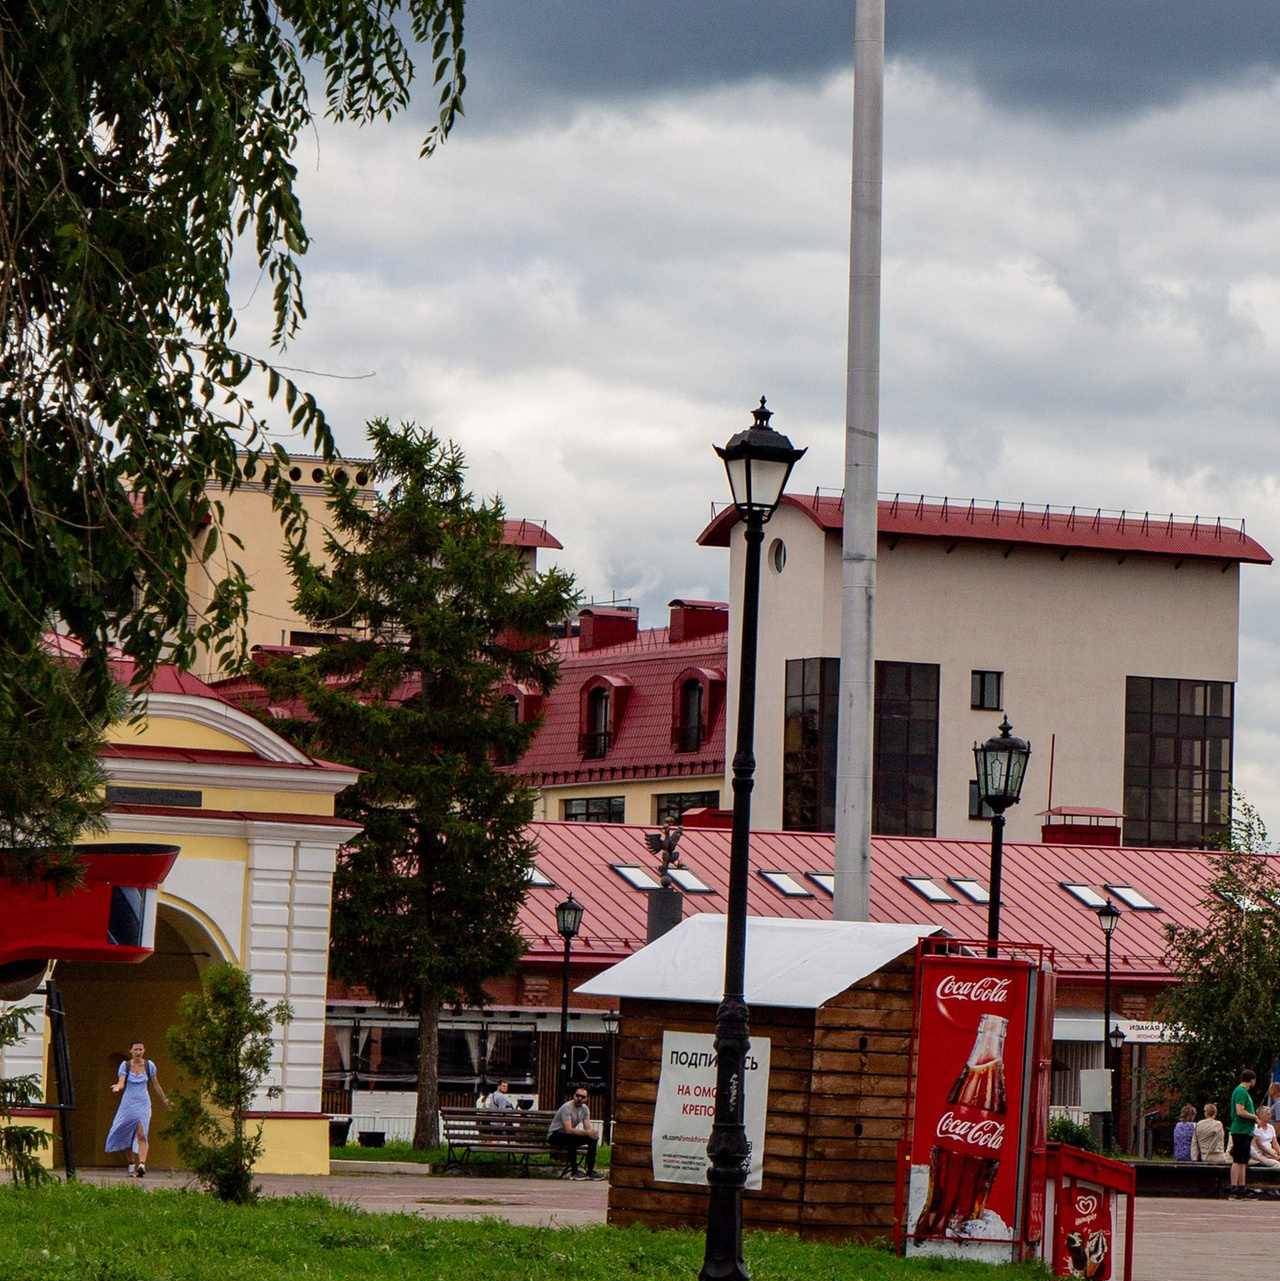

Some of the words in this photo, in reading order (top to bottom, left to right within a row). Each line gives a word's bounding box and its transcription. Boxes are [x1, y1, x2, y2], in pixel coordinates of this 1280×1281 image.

[936, 975, 1012, 1003] Coca-Cola
[670, 1051, 758, 1071] ПОДПИСЬ
[677, 1085, 691, 1096] НА
[694, 1085, 717, 1098] ОМС
[682, 1103, 716, 1117] КРЕПО
[936, 1111, 1005, 1150] Coca-Cola
